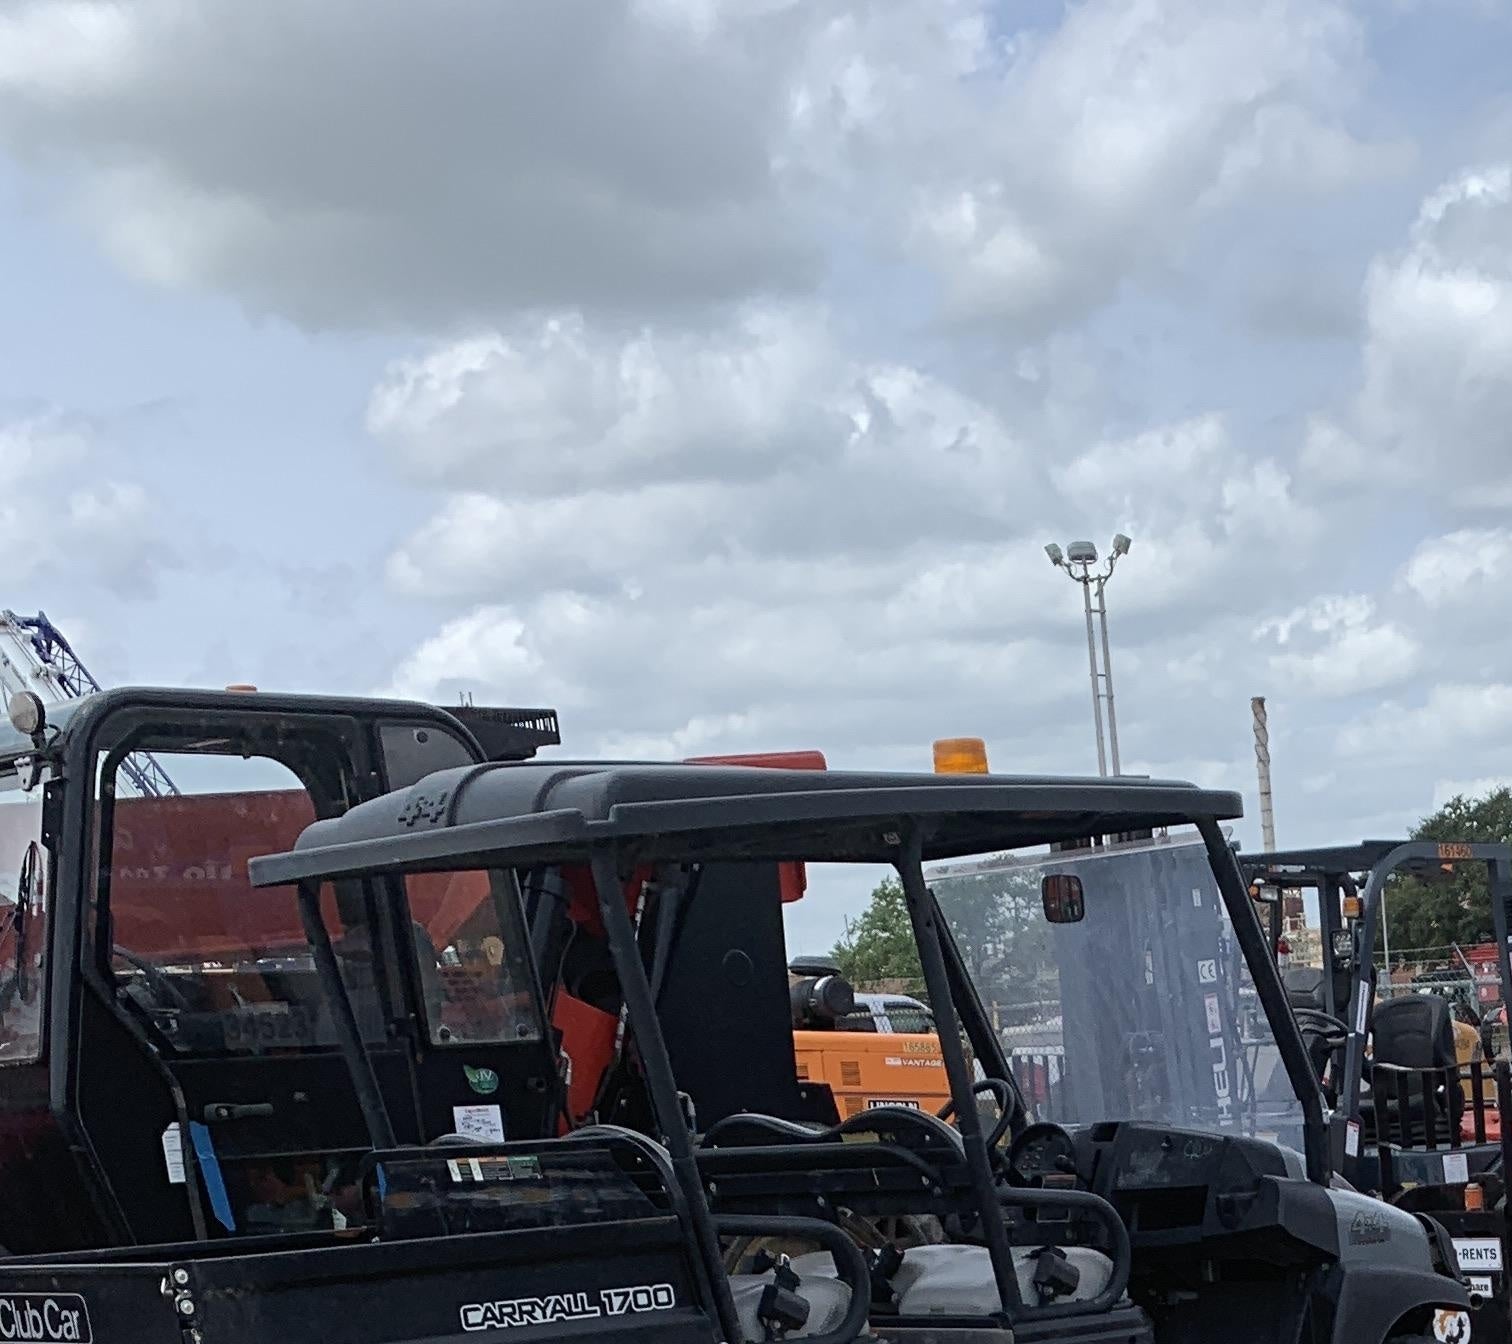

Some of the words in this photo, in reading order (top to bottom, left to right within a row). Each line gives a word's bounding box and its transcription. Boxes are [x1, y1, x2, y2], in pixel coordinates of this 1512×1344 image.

[0, 1298, 43, 1339] Club
[43, 1298, 79, 1340] Car
[460, 1292, 600, 1332] CARRYALL
[600, 1284, 676, 1316] 1700
